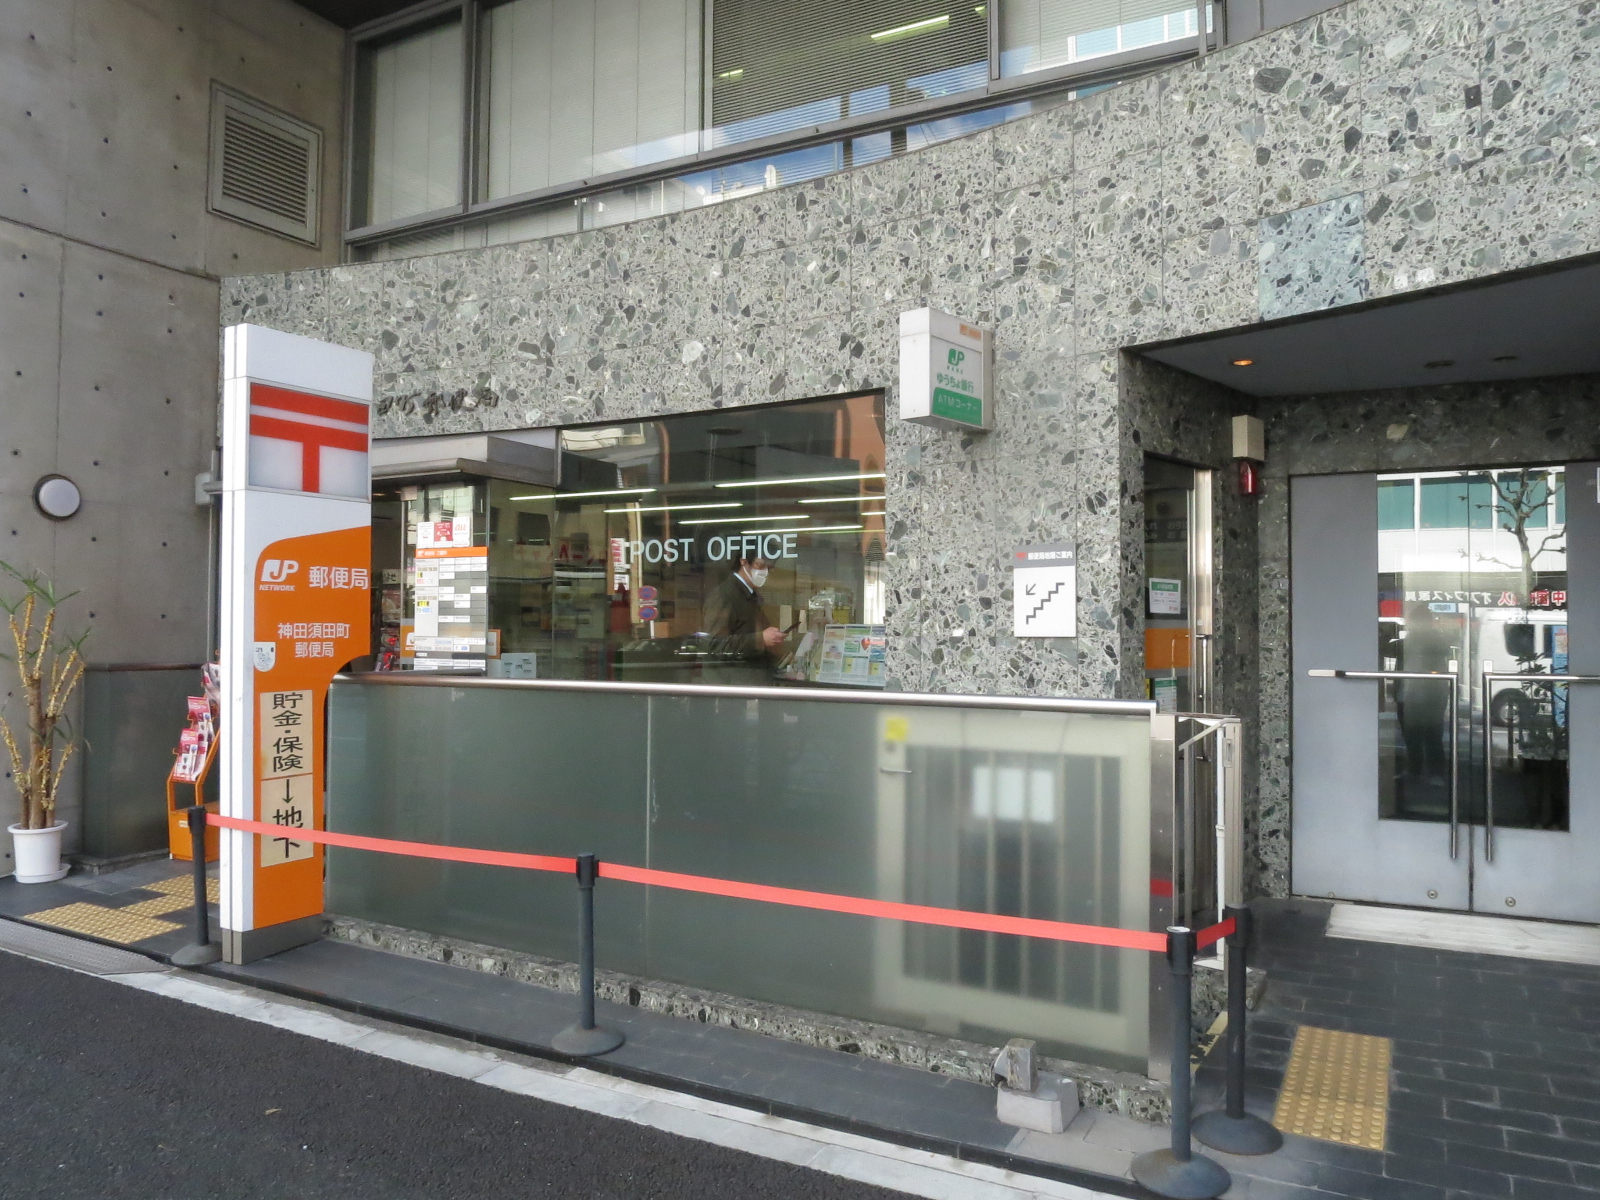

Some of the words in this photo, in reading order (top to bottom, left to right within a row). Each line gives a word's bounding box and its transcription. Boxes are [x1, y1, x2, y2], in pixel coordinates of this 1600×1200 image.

[948, 348, 965, 366] JP
[936, 372, 974, 394] ゆうちょ銀行
[937, 394, 978, 411] ATMコーナー
[630, 538, 694, 563] POST
[707, 533, 798, 561] OFFICE
[261, 559, 299, 582] JP
[309, 566, 368, 590] 郵便局
[259, 584, 295, 592] NETWORK
[278, 623, 350, 639] 神田須田町
[295, 642, 334, 658] 郵便局
[273, 692, 303, 772] 貯金・保険
[273, 806, 303, 858] 地下
